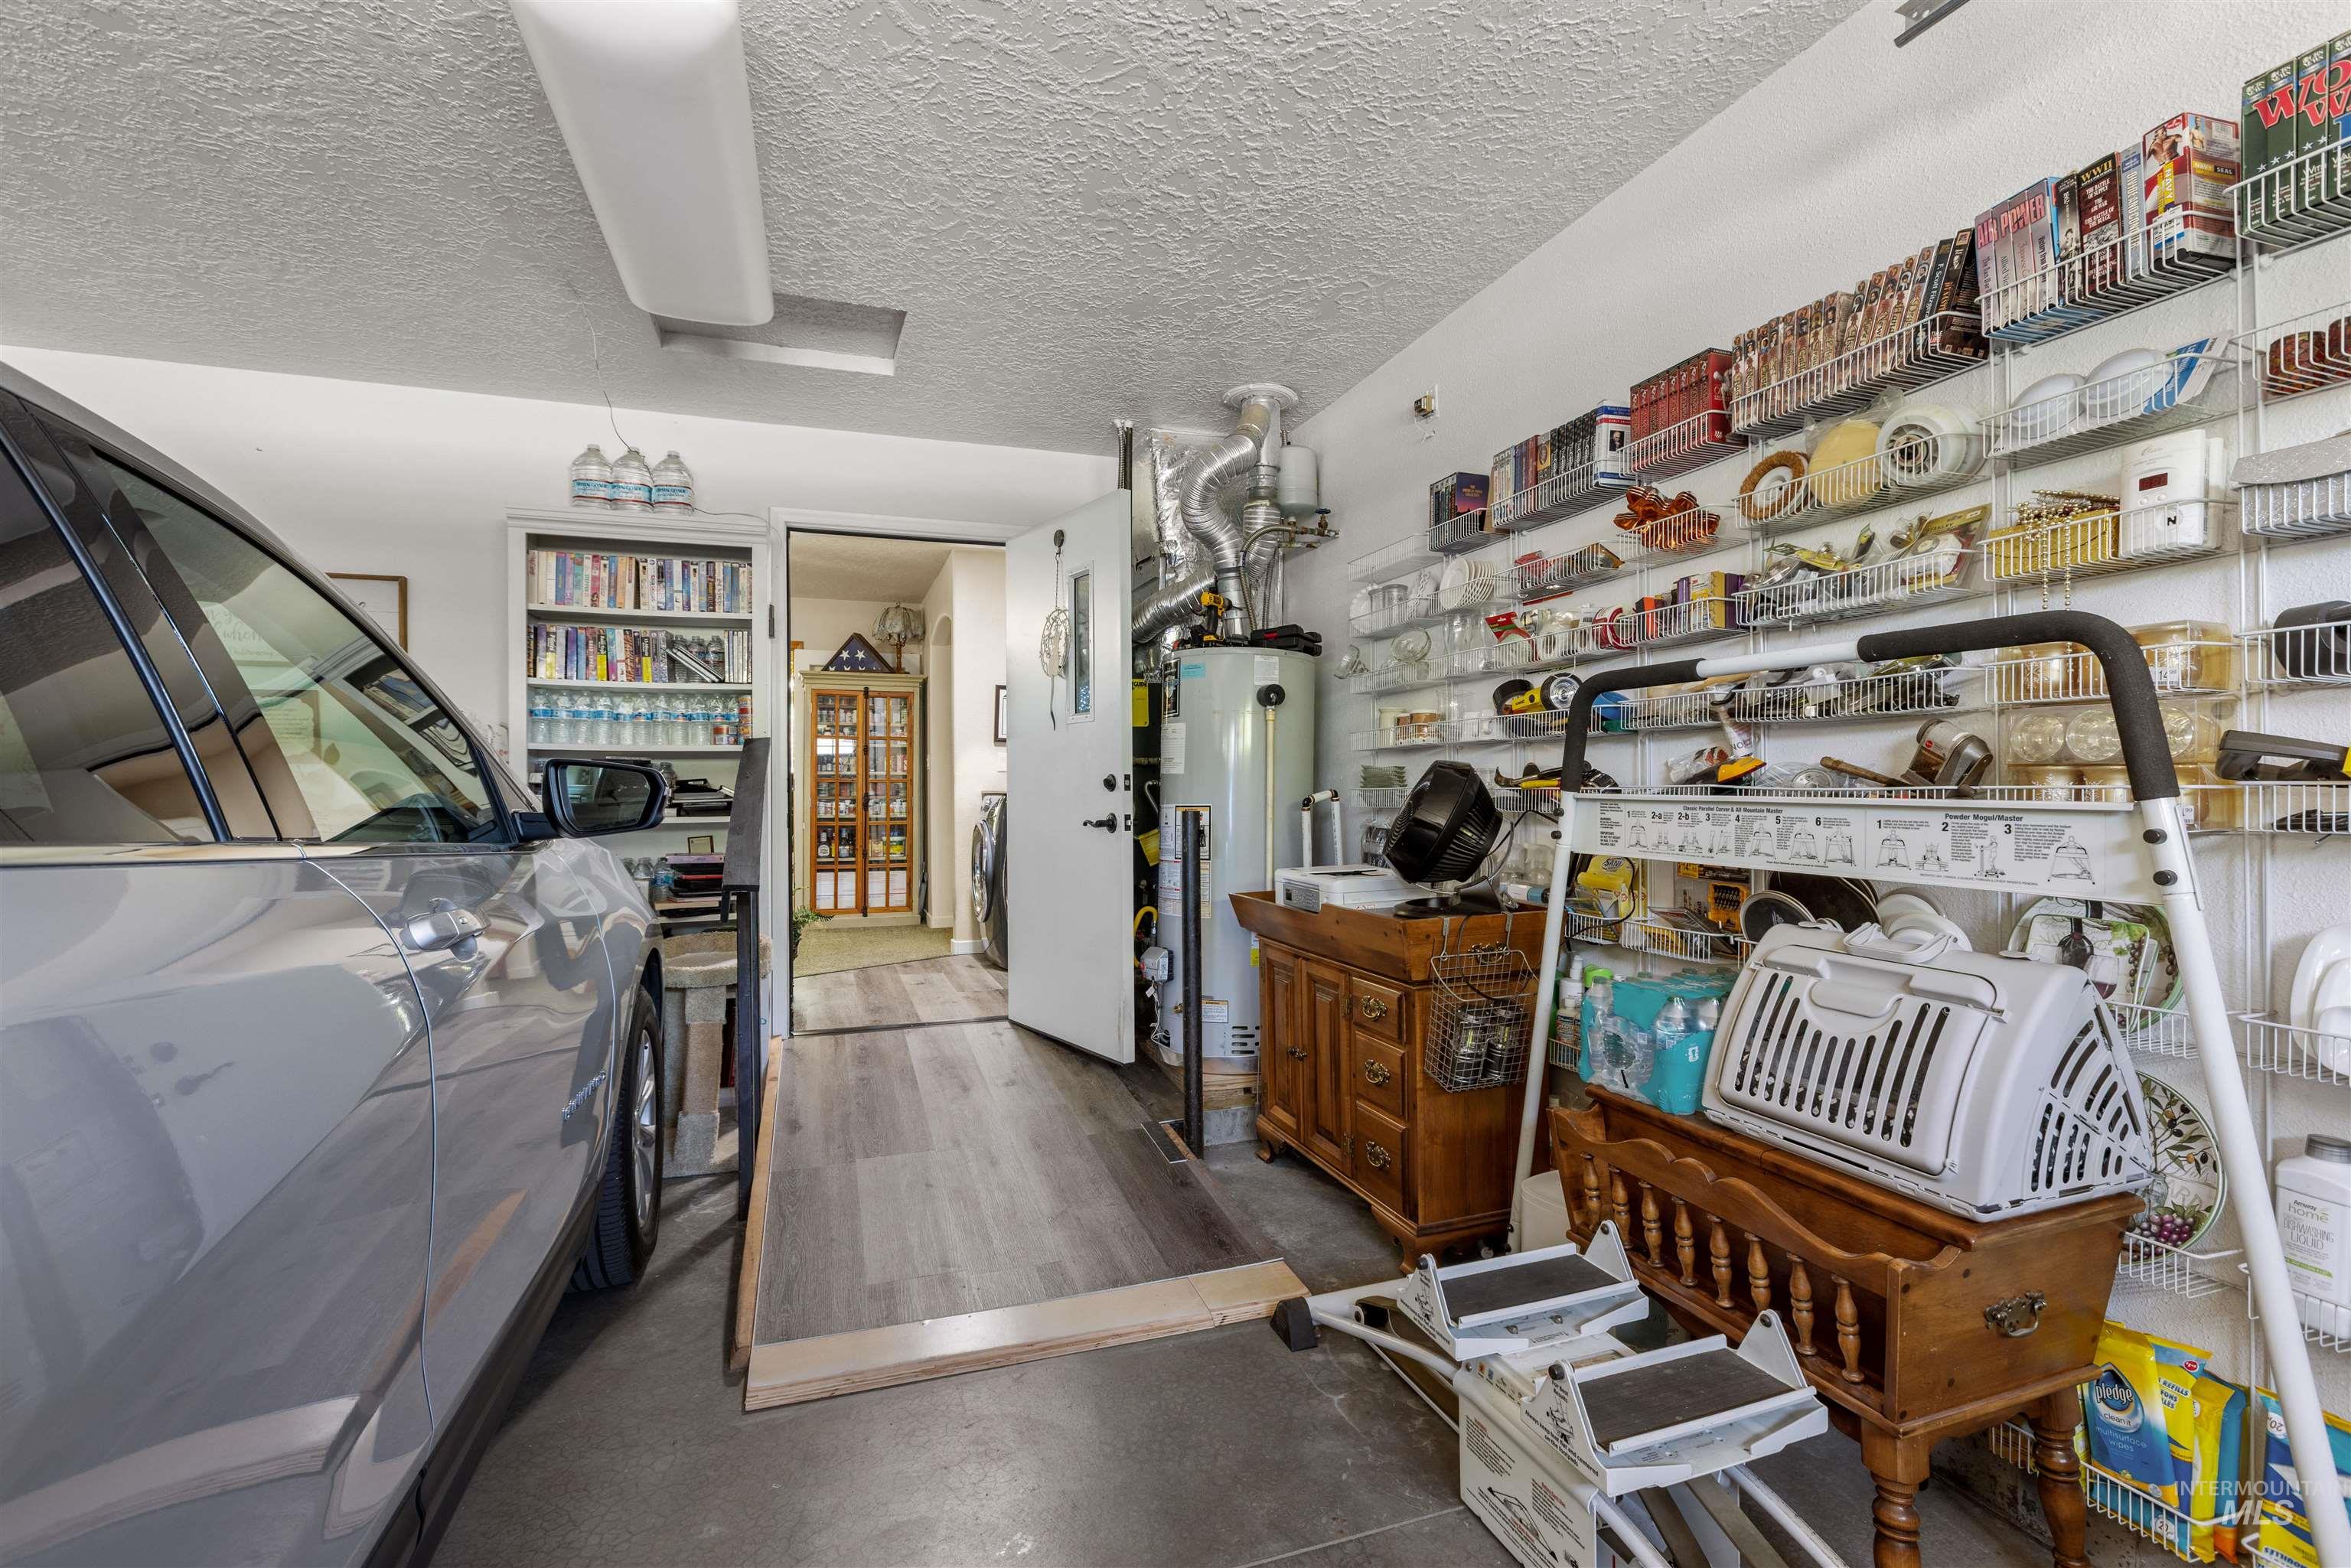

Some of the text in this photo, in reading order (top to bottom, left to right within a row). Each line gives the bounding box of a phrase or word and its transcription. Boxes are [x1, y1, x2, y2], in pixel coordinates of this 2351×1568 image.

[2081, 159, 2114, 182] WWII
[2216, 167, 2233, 175] SEAL
[2094, 178, 2111, 191] BATTLE
[2164, 166, 2175, 200] NAVY
[1977, 217, 1999, 249] AIR
[2000, 193, 2046, 238] POWER
[2092, 209, 2108, 223] BATTLE
[1932, 270, 1942, 290] Scott
[1652, 811, 1662, 820] 2-a
[1678, 812, 1690, 820] 2-b
[1705, 813, 1710, 822] 3
[1735, 814, 1740, 823] 4
[1775, 816, 1781, 824] 5
[1815, 817, 1821, 826] 6
[1972, 813, 2023, 823] Mogul/Master
[1877, 819, 1882, 829] 1
[1942, 822, 1949, 832] 2
[2004, 823, 2012, 834] 3
[2294, 1199, 2317, 1212] Amway
[2288, 1203, 2329, 1224] home
[2284, 1218, 2335, 1244] DISHWASHING
[2291, 1231, 2324, 1250] LIQUID
[2095, 1382, 2134, 1404] pledge
[2163, 1379, 2190, 1397] REFILLS
[1553, 1387, 1568, 1403] Results
[2103, 1412, 2124, 1424] clean
[2269, 1419, 2284, 1433] 20
[1524, 1409, 1540, 1426] Always
[1539, 1422, 1550, 1436] keep
[1577, 1455, 1599, 1477] centered
[2095, 1426, 2147, 1449] multisurface
[2108, 1439, 2134, 1452] wipes
[1558, 1447, 1579, 1468] footpads
